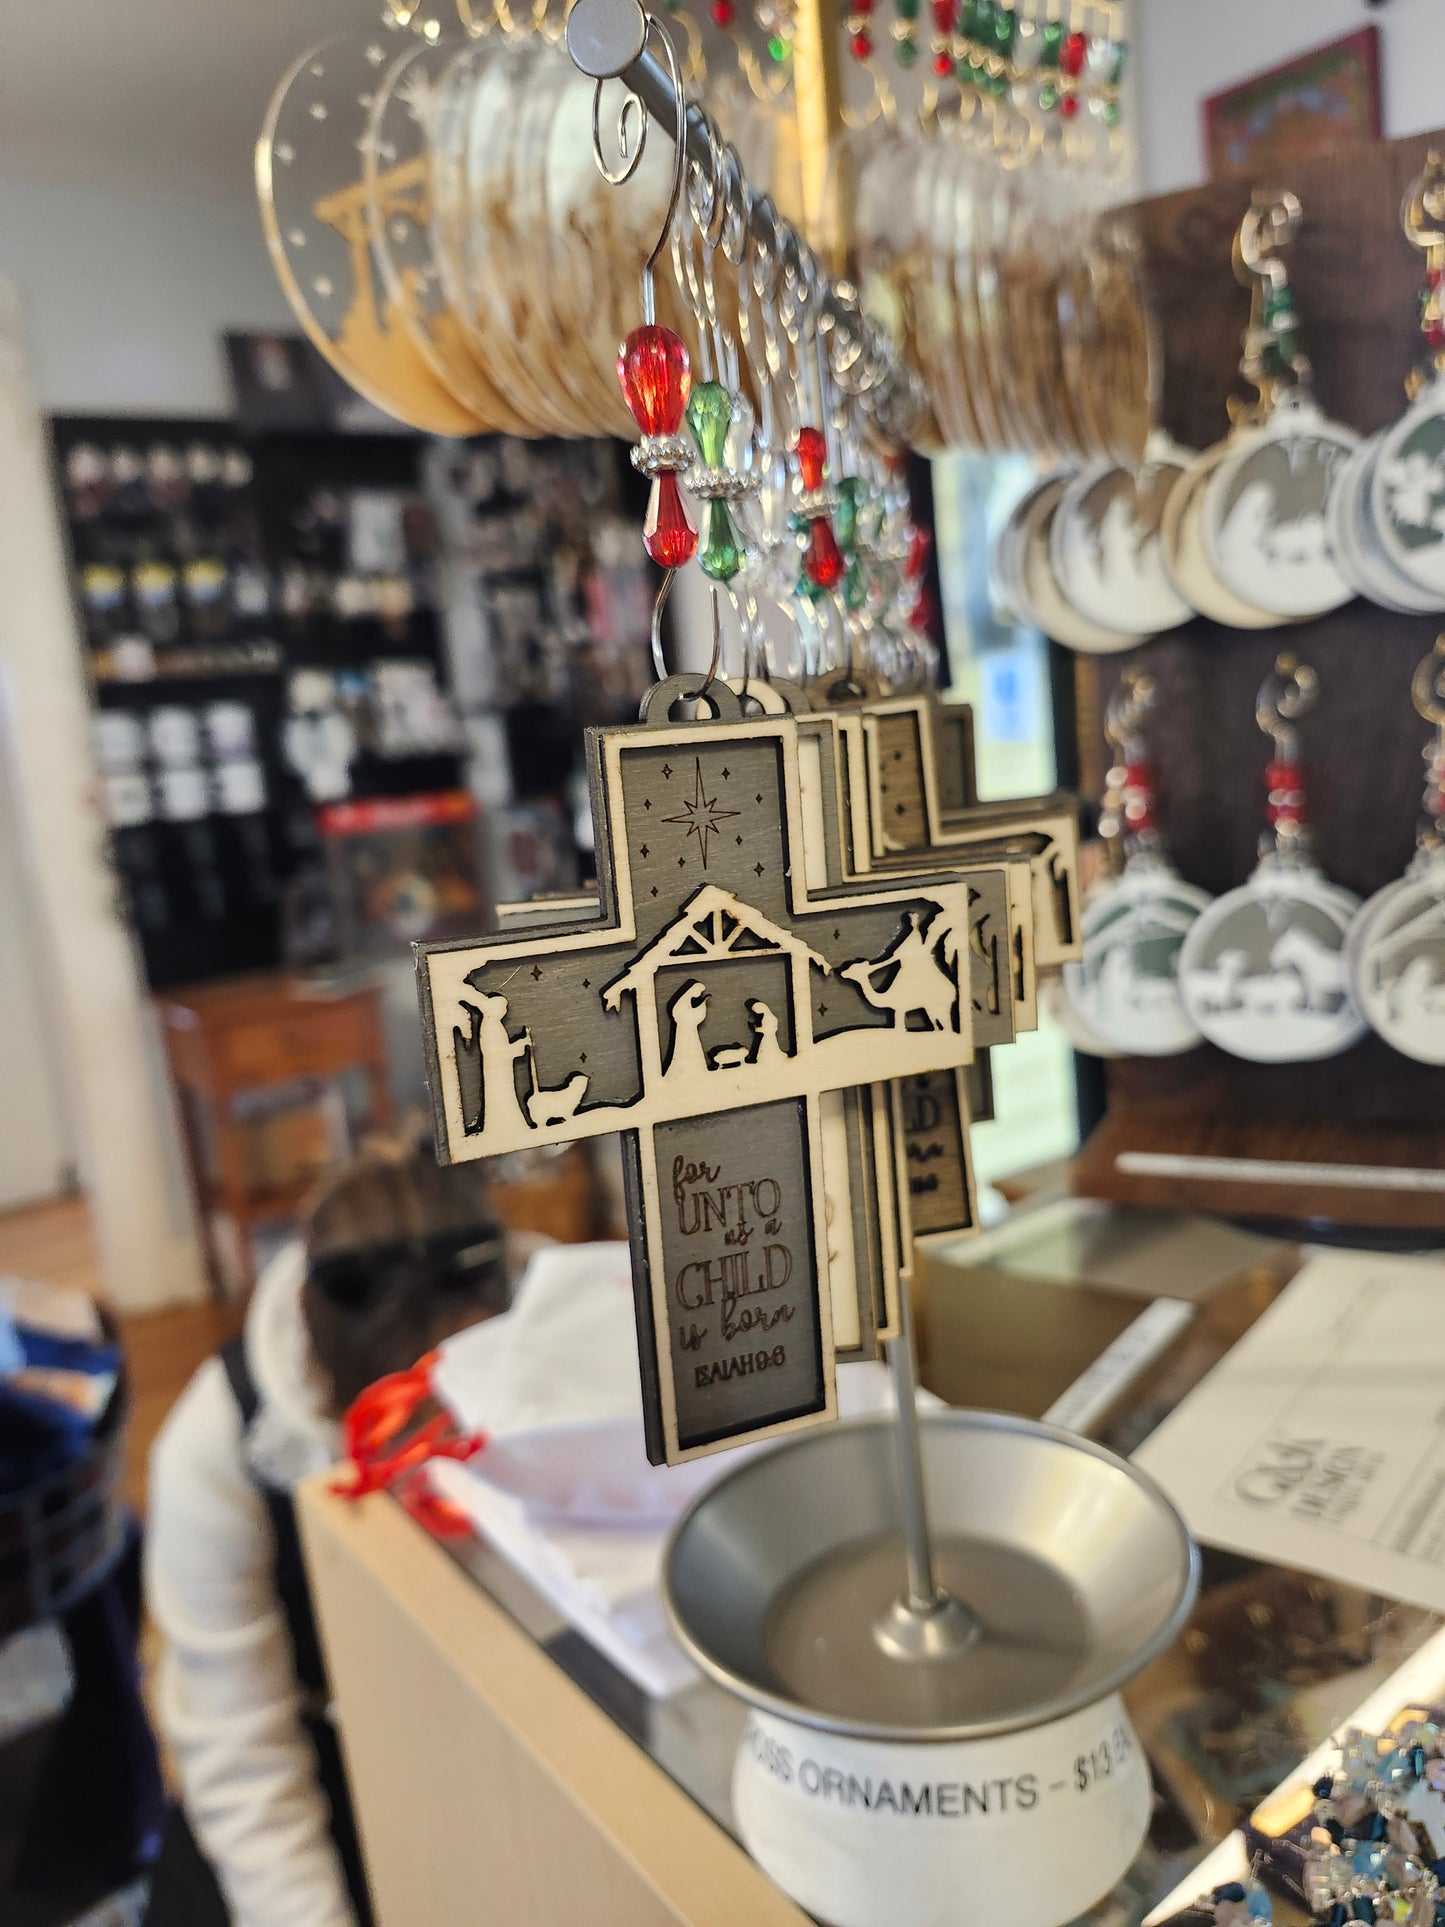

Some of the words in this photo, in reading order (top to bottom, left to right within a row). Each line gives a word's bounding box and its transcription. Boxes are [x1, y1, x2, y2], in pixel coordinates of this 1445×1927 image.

[672, 1155, 721, 1204] for
[677, 1177, 782, 1236] UNTO
[724, 1223, 754, 1246] us
[764, 1216, 783, 1236] a
[675, 1243, 793, 1311] CHILD
[679, 1325, 708, 1351] is
[720, 1291, 796, 1341] born
[695, 1353, 754, 1388] ISAIAH
[799, 1757, 1040, 1818] ORNAMENTS
